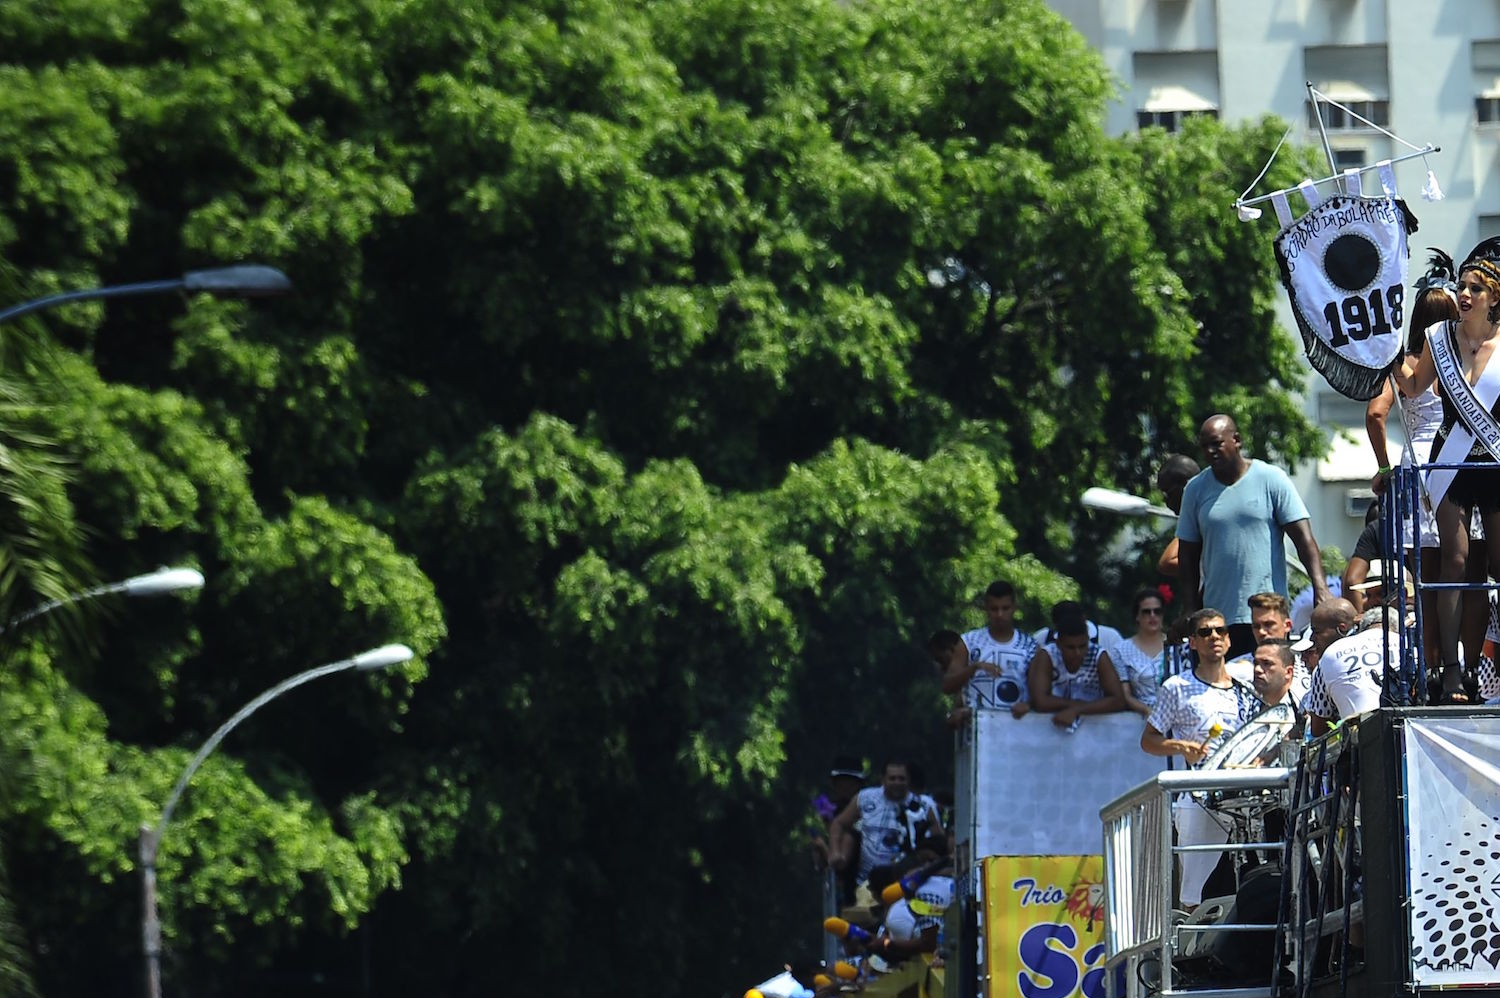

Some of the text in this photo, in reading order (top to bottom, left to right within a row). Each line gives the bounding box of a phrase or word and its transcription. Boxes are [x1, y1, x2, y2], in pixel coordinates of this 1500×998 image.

[1324, 283, 1403, 347] 1918
[1435, 339, 1452, 371] PORTA
[1446, 372, 1491, 433] ESTANDARTE
[1014, 878, 1063, 906] Trio
